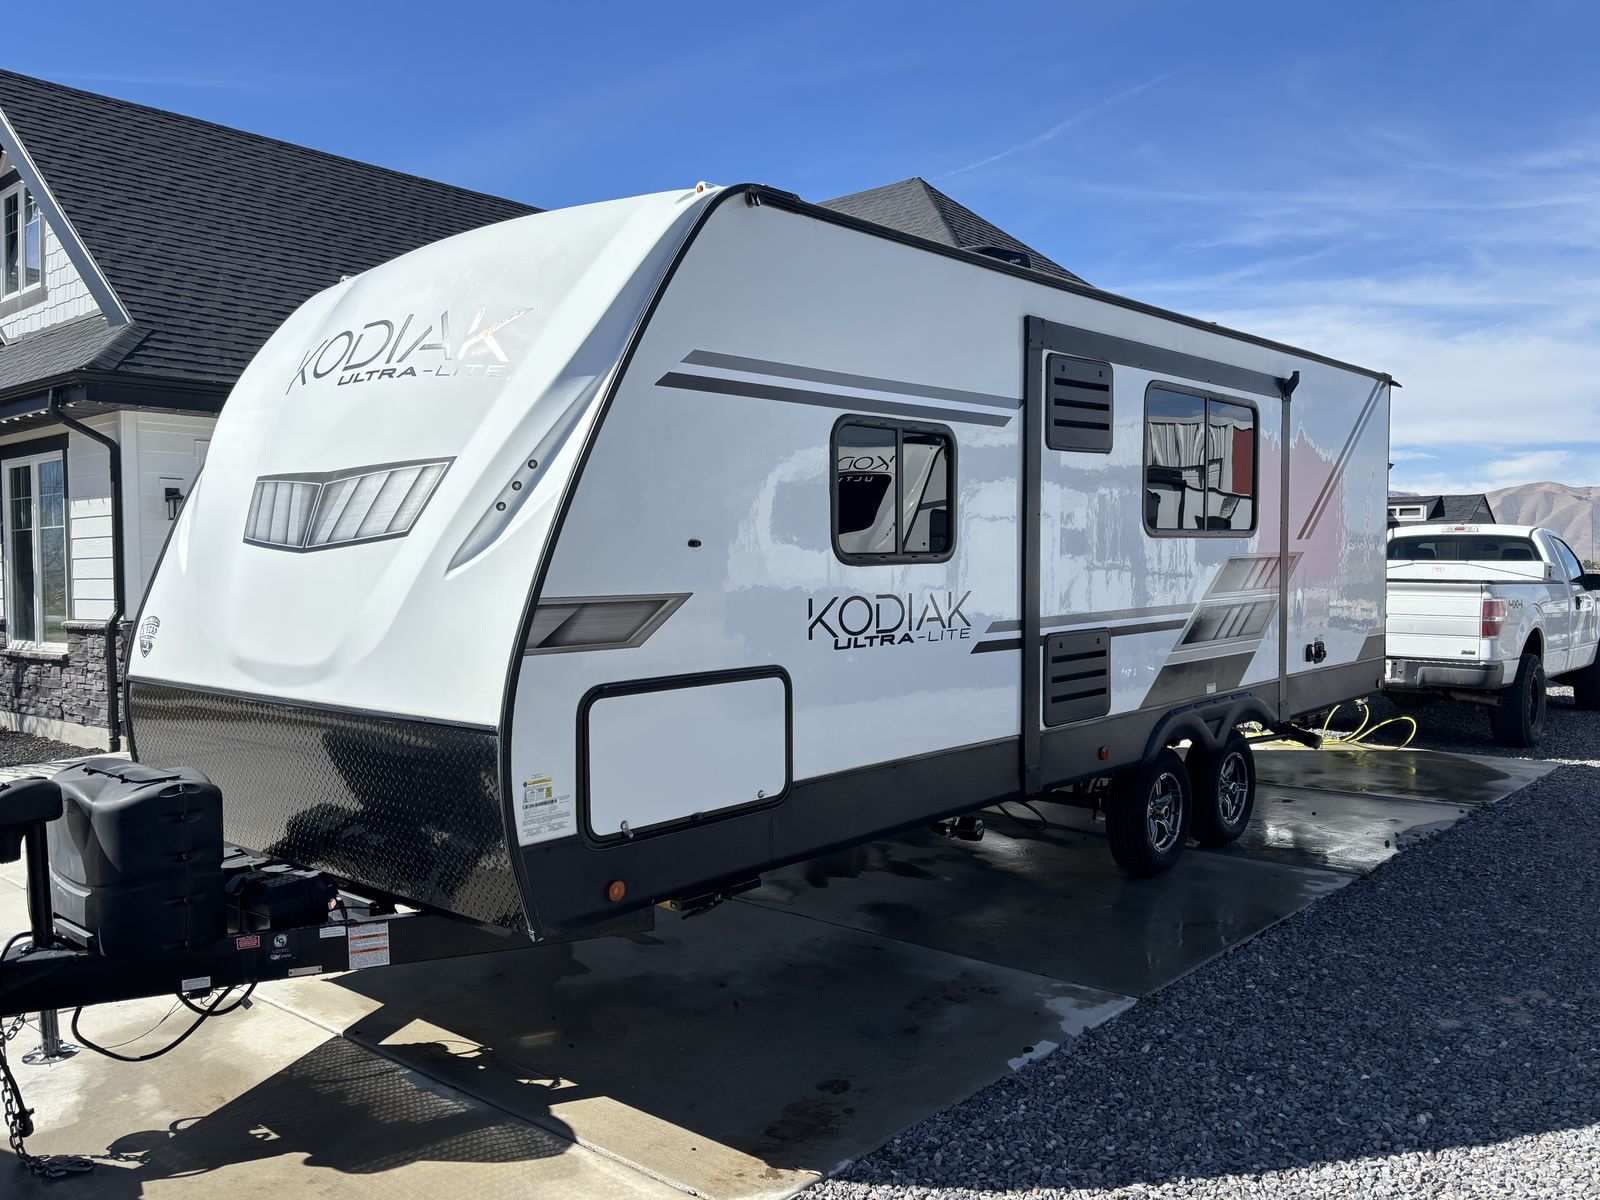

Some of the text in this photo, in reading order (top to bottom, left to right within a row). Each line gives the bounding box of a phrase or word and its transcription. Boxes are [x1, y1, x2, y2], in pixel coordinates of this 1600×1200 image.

[285, 307, 535, 396] KODIAK
[337, 364, 506, 386] ULTRA-LITE
[808, 590, 972, 641] KODIAK
[834, 628, 972, 651] ULTRA-LITE
